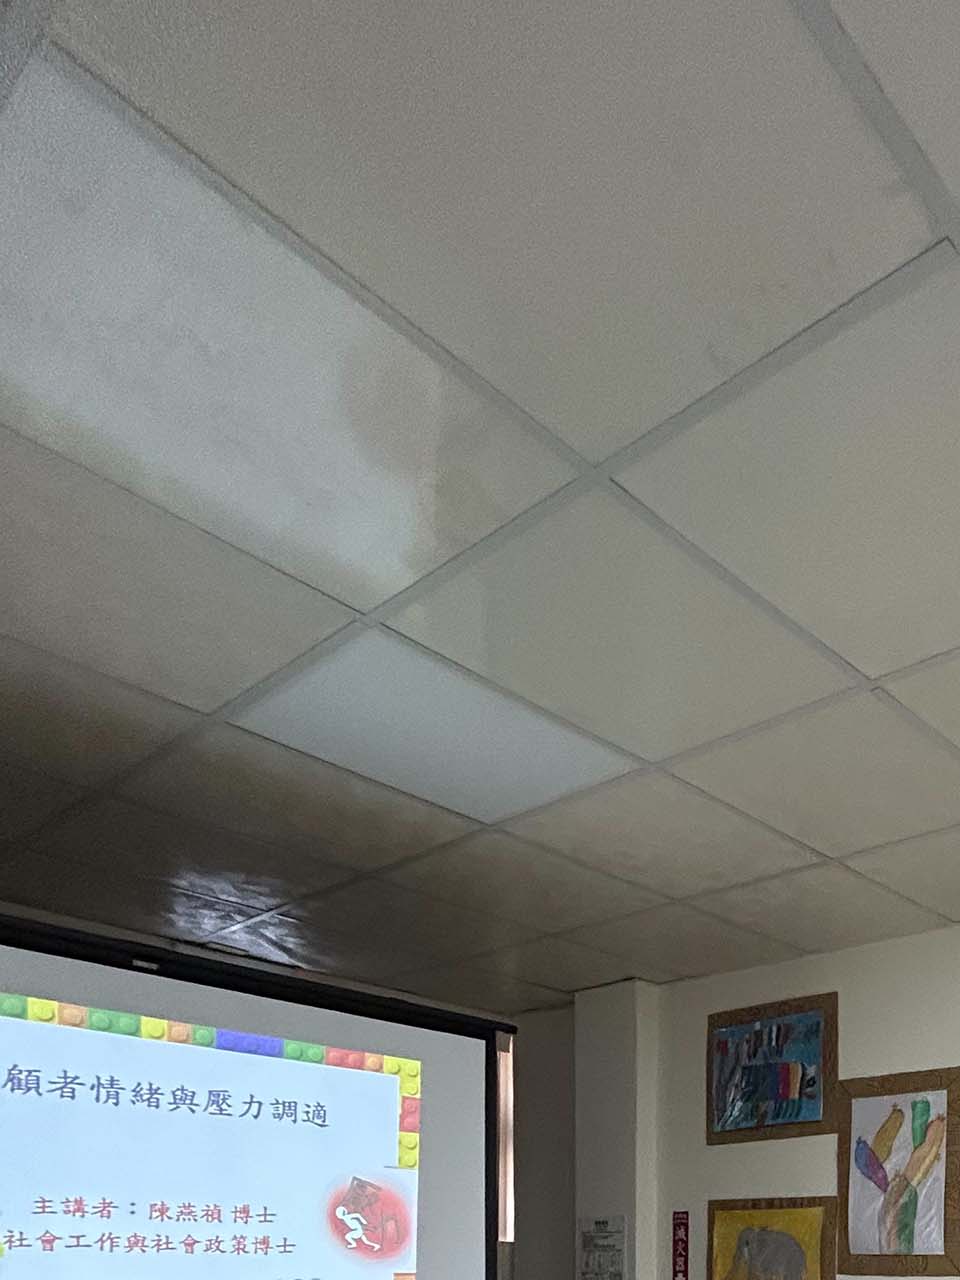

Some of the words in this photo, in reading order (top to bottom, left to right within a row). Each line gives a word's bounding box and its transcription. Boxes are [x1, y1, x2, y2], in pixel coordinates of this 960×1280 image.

[2, 1064, 329, 1128] 顧者情緒與壓力調適
[2, 1230, 297, 1255] 社會工作與社會政策博士
